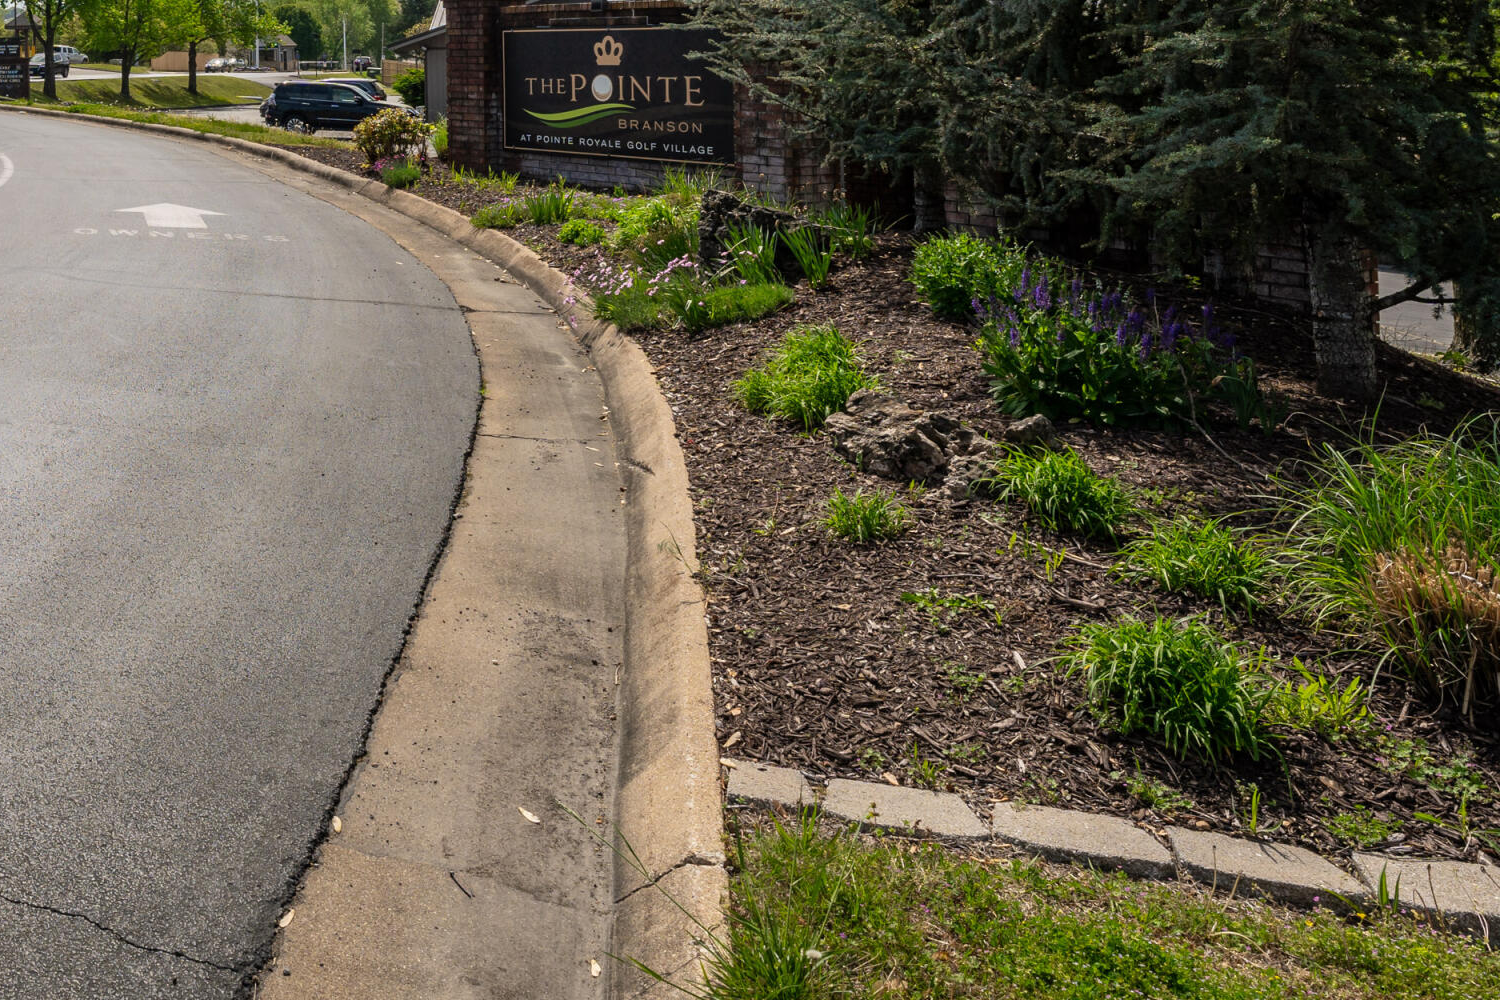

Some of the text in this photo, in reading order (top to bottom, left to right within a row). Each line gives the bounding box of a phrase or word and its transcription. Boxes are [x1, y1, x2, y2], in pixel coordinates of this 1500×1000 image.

[525, 73, 706, 107] THE POINTE
[618, 119, 703, 134] BRANSON
[520, 134, 714, 155] AT POINTE ROYALE GOLF VILLAGE
[73, 227, 291, 242] OWNERS
